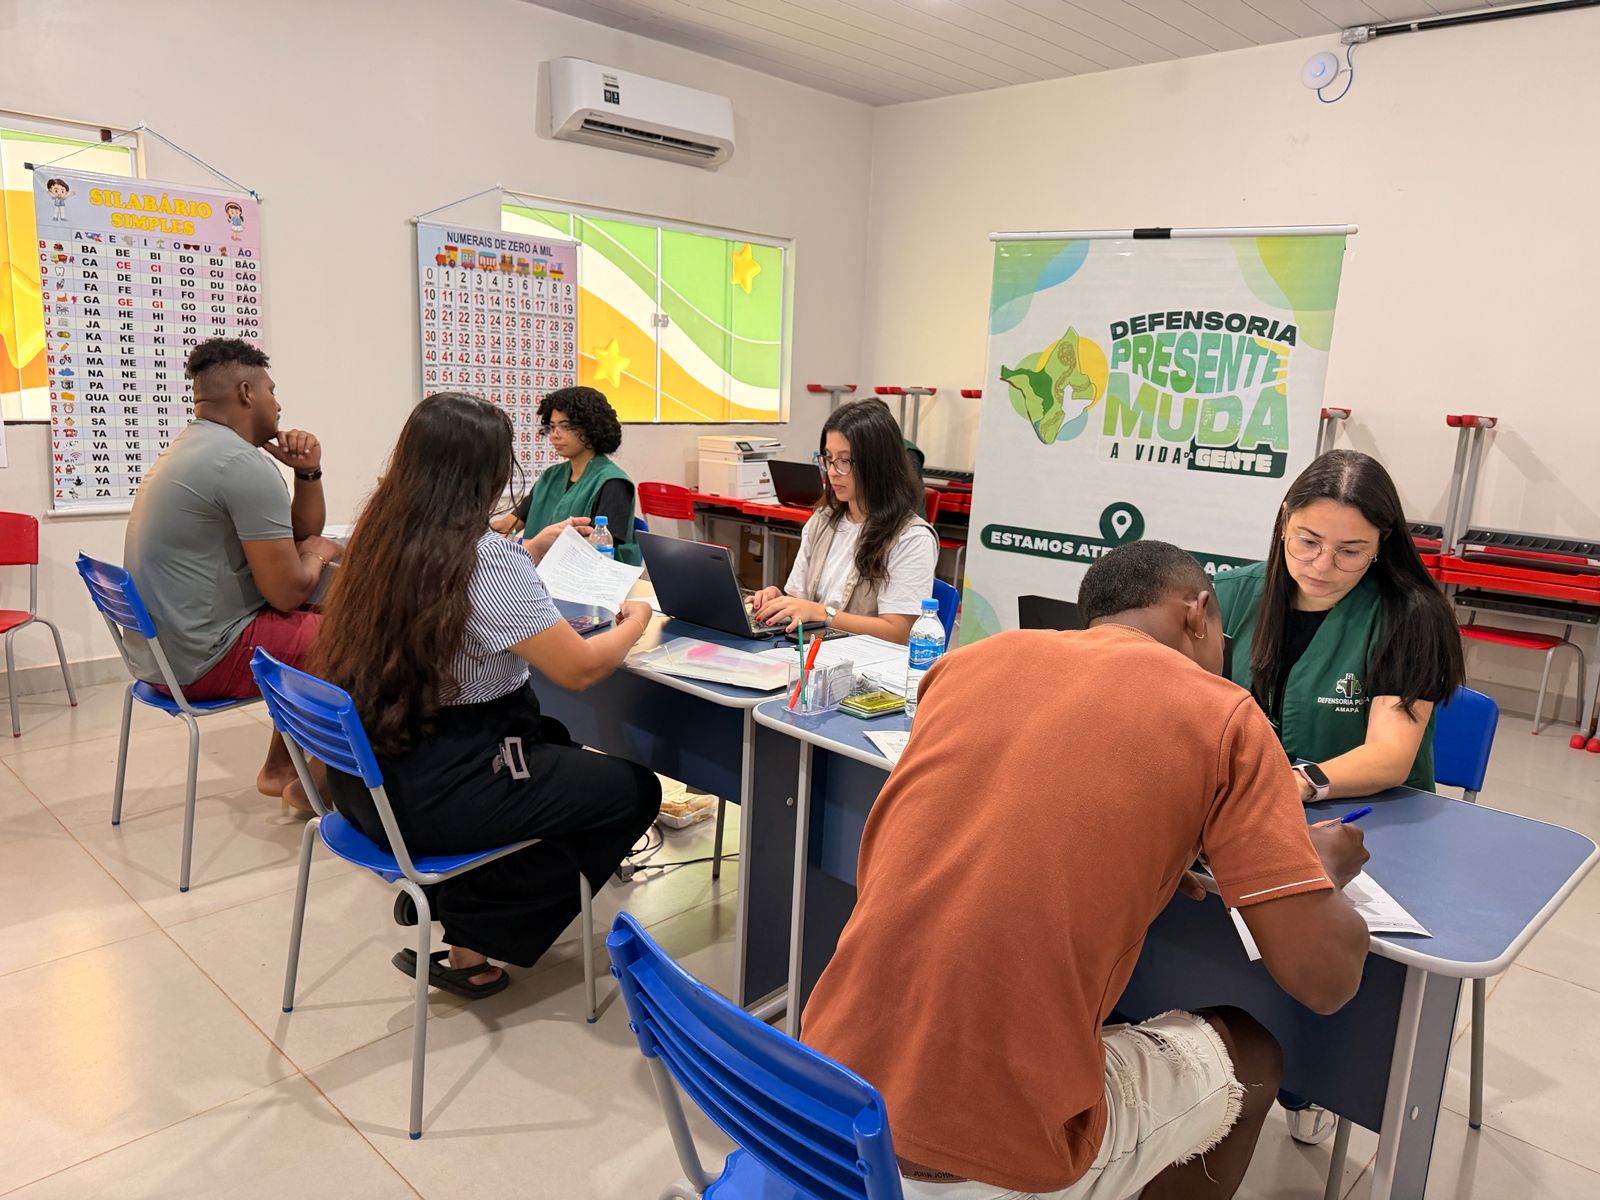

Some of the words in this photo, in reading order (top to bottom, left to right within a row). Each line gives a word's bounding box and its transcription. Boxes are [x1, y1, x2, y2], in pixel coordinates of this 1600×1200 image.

[89, 188, 212, 219] SILABÁRIO
[111, 213, 195, 236] SIMPLES
[75, 232, 83, 240] A
[109, 235, 115, 243] E
[173, 242, 180, 250] O
[204, 245, 211, 253] U
[447, 232, 492, 248] NUMERAIS
[495, 240, 506, 249] DE
[509, 241, 530, 253] ZERO
[532, 245, 539, 253] A
[540, 246, 553, 256] MIL
[82, 245, 97, 254] BA
[116, 249, 130, 257] BE
[179, 255, 194, 263] BO
[210, 258, 223, 266] BU
[82, 258, 98, 267] CA
[116, 262, 131, 270] CE
[180, 267, 194, 275] CO
[210, 270, 223, 278] CU
[83, 271, 98, 279] DA
[118, 274, 131, 282] DE
[180, 280, 195, 288] DO
[210, 282, 224, 290] DU
[427, 268, 433, 279] 0
[445, 271, 449, 281] 1
[461, 272, 466, 283] 2
[477, 274, 482, 285] 3
[492, 276, 497, 286] 4
[508, 278, 513, 288] 5
[523, 280, 528, 290] 6
[538, 282, 542, 292] 7
[552, 284, 557, 293] 8
[566, 285, 570, 295] 9
[84, 284, 98, 292] FA
[211, 294, 224, 302] FU
[424, 289, 435, 299] 10
[442, 292, 453, 301] 11
[458, 292, 469, 303] 12
[474, 294, 485, 305] 13
[490, 296, 500, 306] 14
[505, 298, 516, 308] 15
[520, 299, 530, 310] 16
[535, 301, 545, 311] 17
[550, 302, 559, 312] 18
[563, 304, 573, 314] 19
[84, 296, 100, 304] GA
[118, 298, 133, 306] GE
[152, 301, 163, 309] GI
[181, 303, 196, 311] GO
[84, 308, 100, 317] HA
[119, 310, 133, 318] HE
[182, 315, 196, 323] HO
[425, 309, 436, 320] 20
[442, 311, 453, 321] 21
[459, 312, 470, 323] 22
[475, 313, 485, 324] 23
[490, 315, 500, 325] 24
[506, 316, 516, 327] 25
[521, 318, 531, 328] 26
[536, 320, 545, 330] 27
[550, 321, 559, 331] 28
[563, 322, 573, 332] 29
[86, 321, 100, 329] JA
[120, 323, 133, 331] JE
[1110, 311, 1297, 347] DEFENSORIA
[86, 333, 102, 341] KA
[120, 335, 135, 343] KE
[183, 338, 197, 346] KO
[425, 331, 436, 342] 30
[442, 332, 453, 343] 31
[459, 333, 470, 344] 32
[475, 334, 486, 345] 33
[490, 335, 500, 346] 34
[506, 337, 516, 347] 35
[521, 338, 531, 348] 36
[535, 340, 545, 350] 37
[550, 341, 559, 351] 38
[563, 342, 573, 352] 39
[122, 347, 134, 355] LE
[87, 358, 104, 366] MA
[121, 359, 136, 367] ME
[155, 360, 166, 368] MI
[1110, 331, 1288, 394] PRESENTE
[90, 382, 104, 390] PA
[85, 393, 109, 402] QUA
[119, 394, 142, 402] QUE
[152, 395, 171, 403] QUI
[158, 407, 167, 415] RI
[1103, 372, 1289, 450] MUDA
[92, 418, 106, 426] SA
[92, 430, 107, 438] TA
[521, 451, 531, 460] 96
[535, 451, 545, 461] 97
[1110, 443, 1119, 459] A
[1136, 443, 1182, 464] VIDA
[1195, 449, 1272, 472] GENTE
[127, 465, 141, 473] XE
[96, 489, 110, 497] ZA
[991, 532, 1074, 555] ESTAMOS
[1318, 697, 1353, 705] DEFENSORIA
